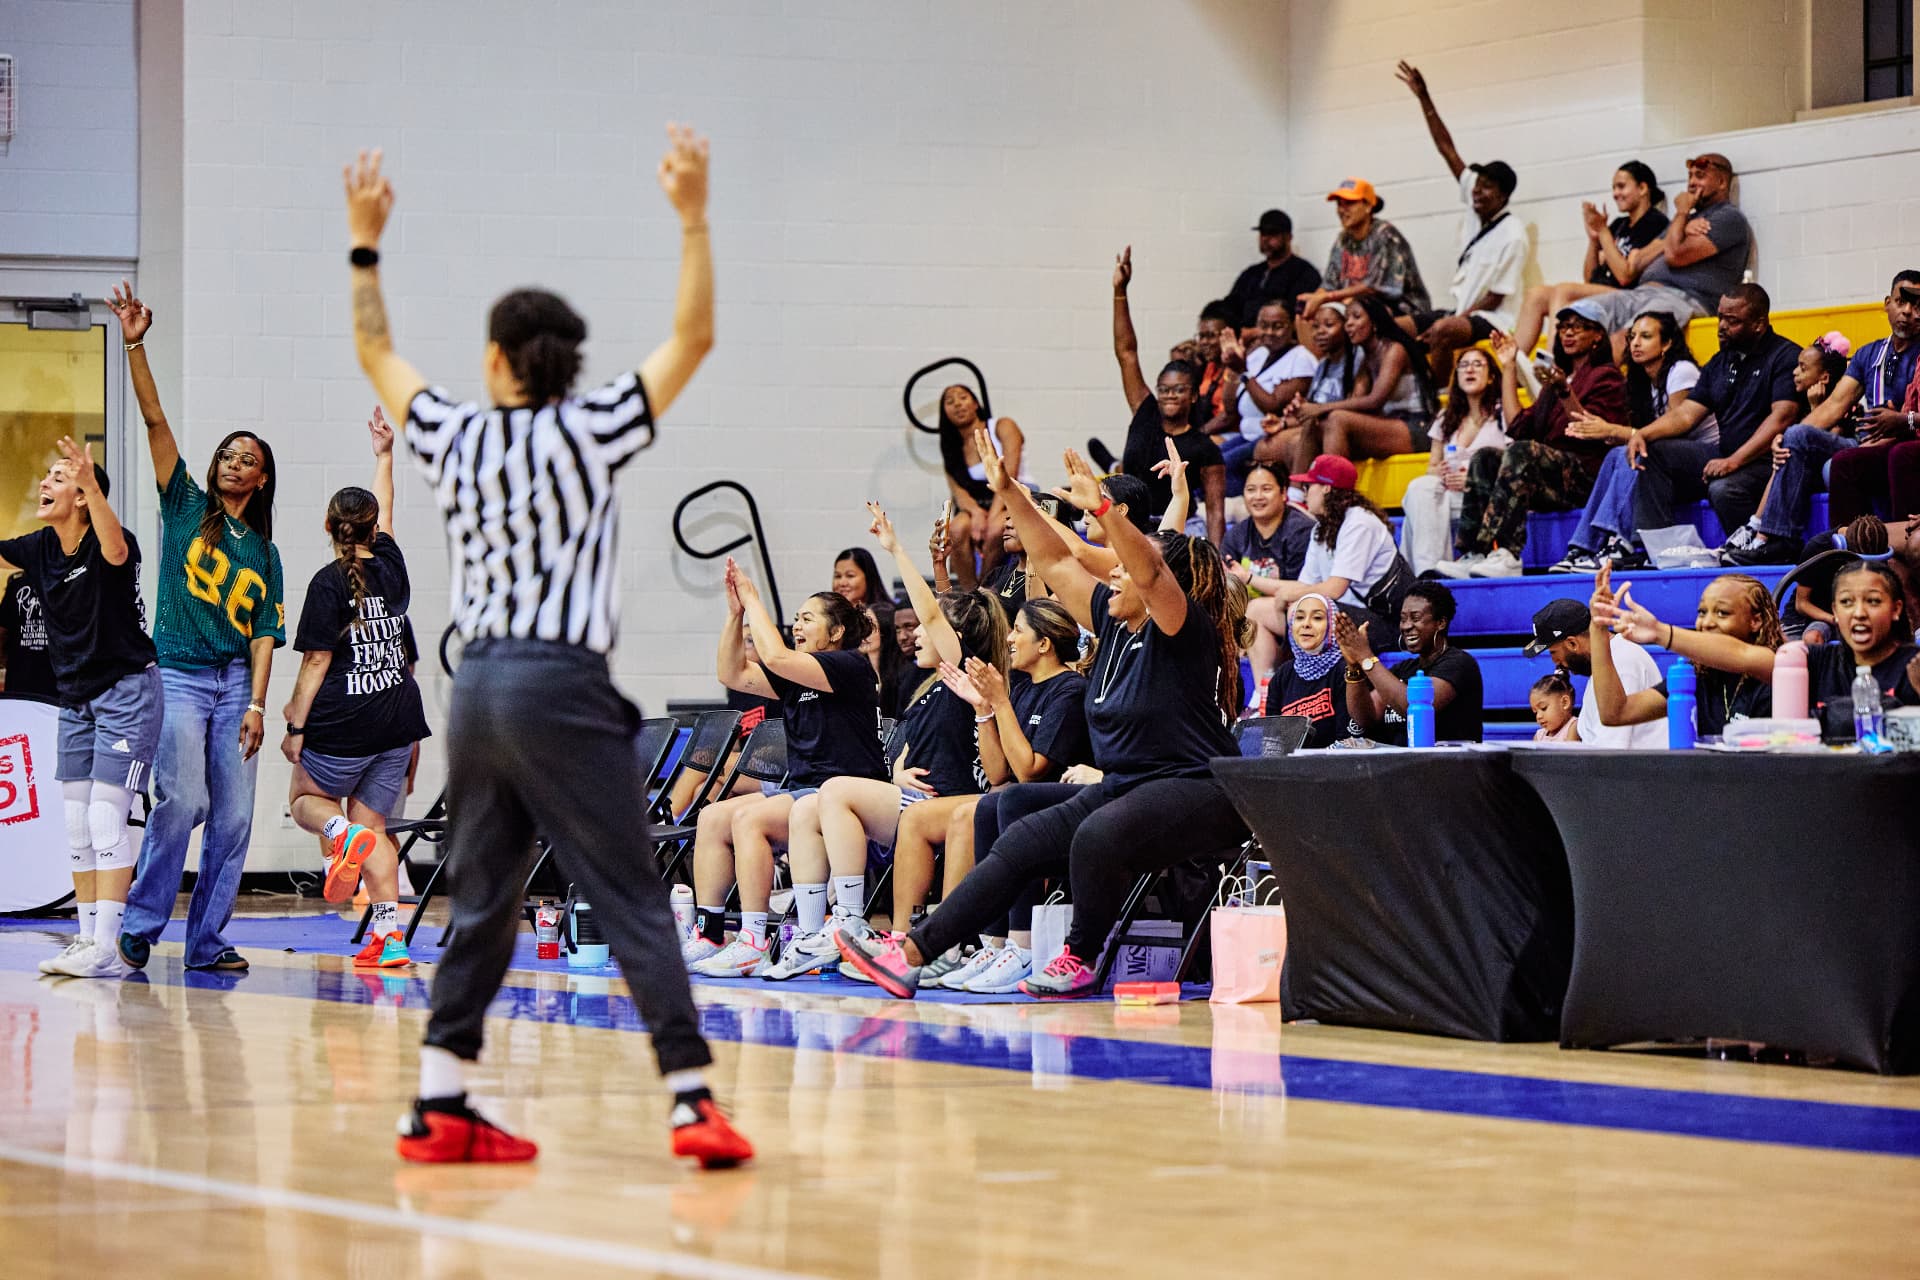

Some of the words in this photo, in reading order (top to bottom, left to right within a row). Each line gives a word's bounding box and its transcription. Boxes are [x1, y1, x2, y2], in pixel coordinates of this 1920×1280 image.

[348, 596, 388, 620] THE
[350, 614, 405, 645] FUTUR
[346, 668, 404, 695] HOOPS
